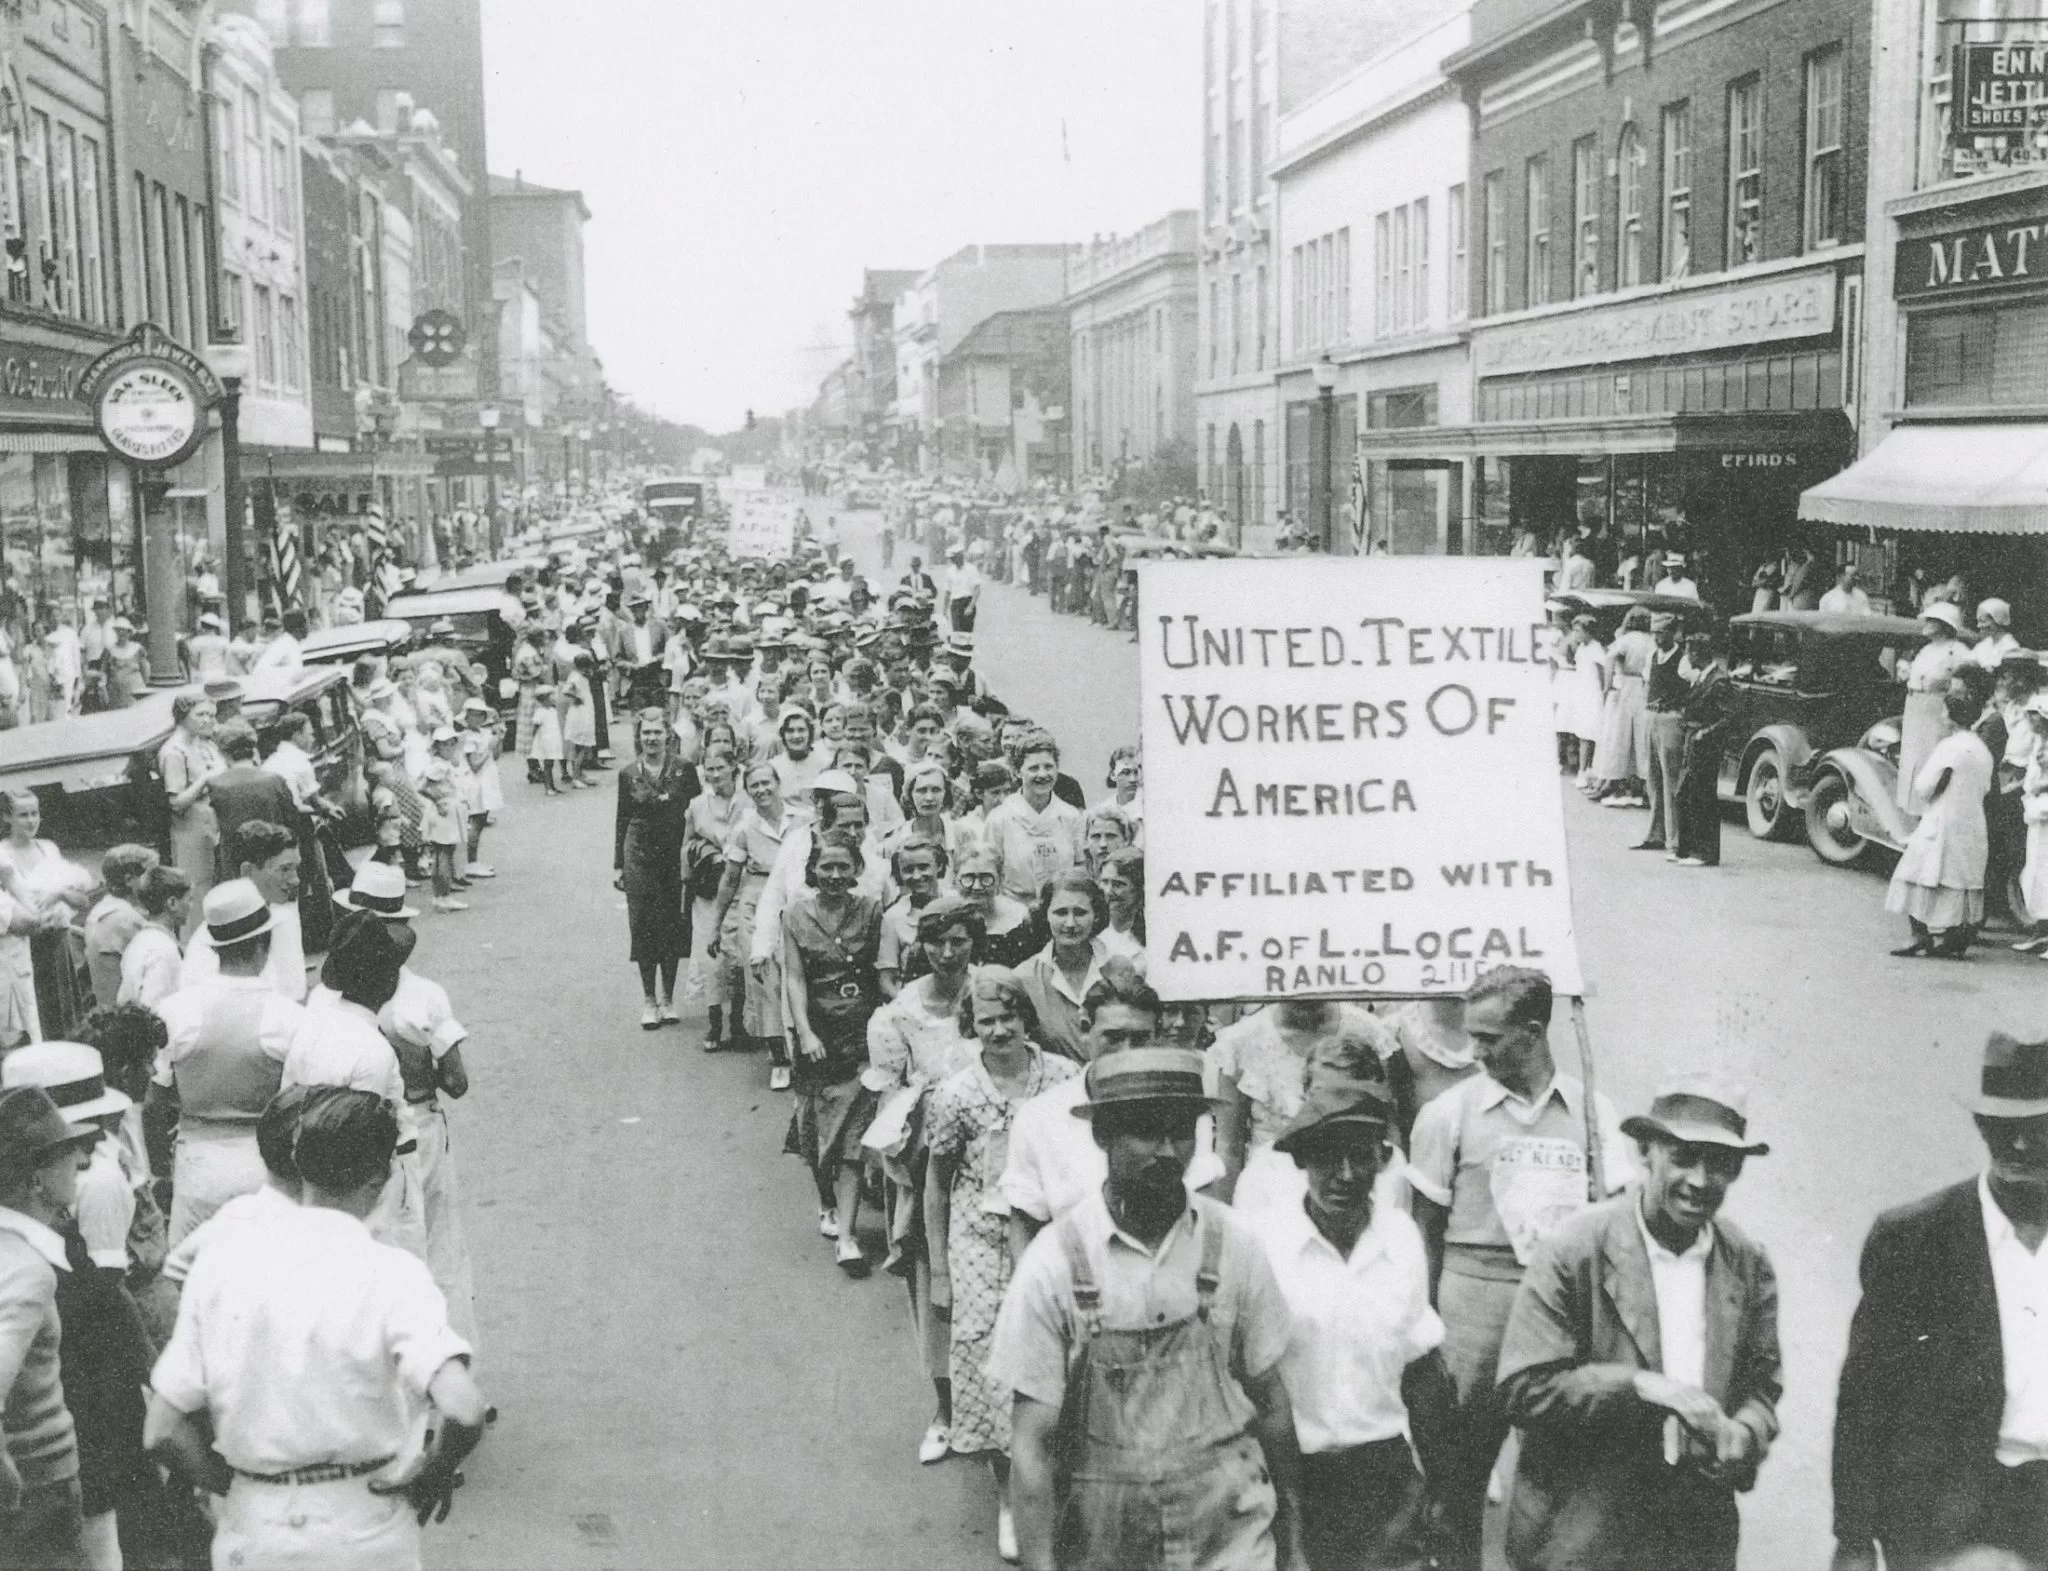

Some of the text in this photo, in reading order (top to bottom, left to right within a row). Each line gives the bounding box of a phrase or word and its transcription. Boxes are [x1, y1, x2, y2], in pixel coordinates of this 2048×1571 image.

[1972, 109, 2022, 124] SHOES
[1926, 224, 2048, 287] MAT
[1361, 617, 1551, 667] TEXTILE
[1161, 684, 1516, 745] WORKERS OF
[1205, 767, 1417, 817] AMERICA
[1160, 867, 1414, 897] AFFILIATED
[1261, 936, 1310, 960] OF
[1383, 922, 1544, 960] LOCAL
[1266, 961, 1385, 992] RANLO
